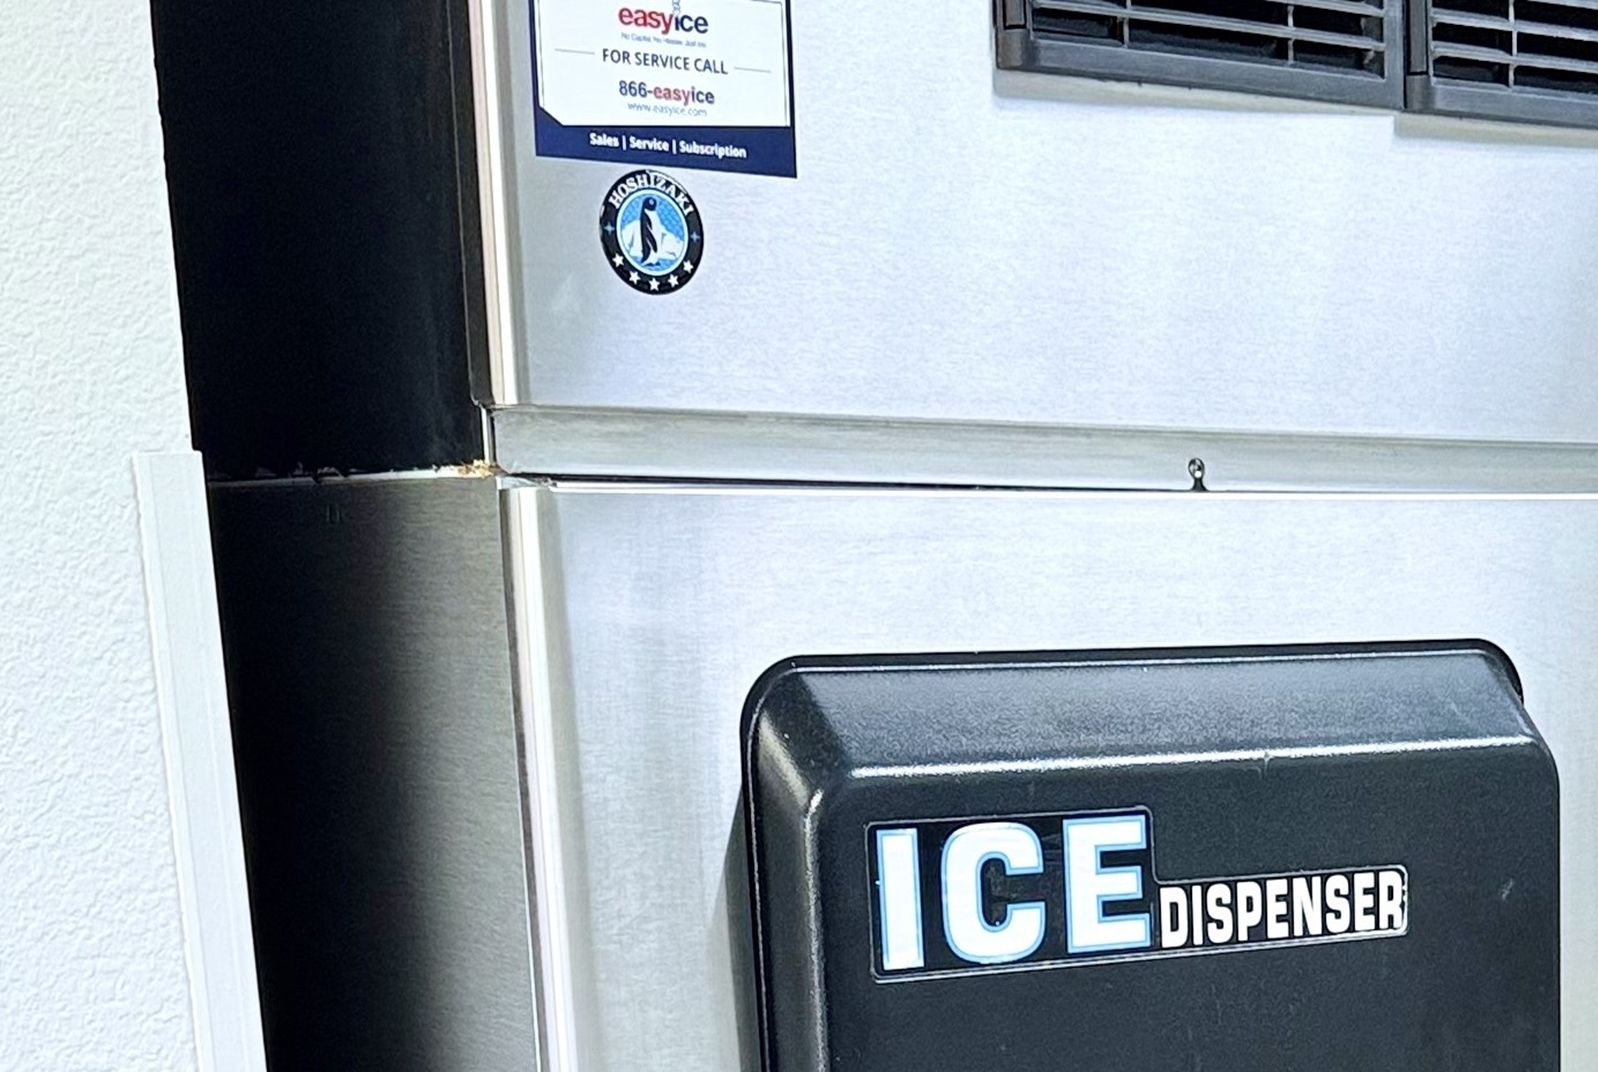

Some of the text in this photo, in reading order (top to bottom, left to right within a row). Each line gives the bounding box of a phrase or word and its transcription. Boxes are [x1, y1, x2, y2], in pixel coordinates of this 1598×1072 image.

[618, 7, 709, 34] easyice
[602, 48, 729, 75] FOR SERVICE CALL
[619, 80, 715, 106] 866-easyice
[590, 132, 748, 159] Sales Service Subscription
[608, 173, 695, 216] HOSHIZAKI
[876, 814, 1405, 971] ICE DISPENSER
